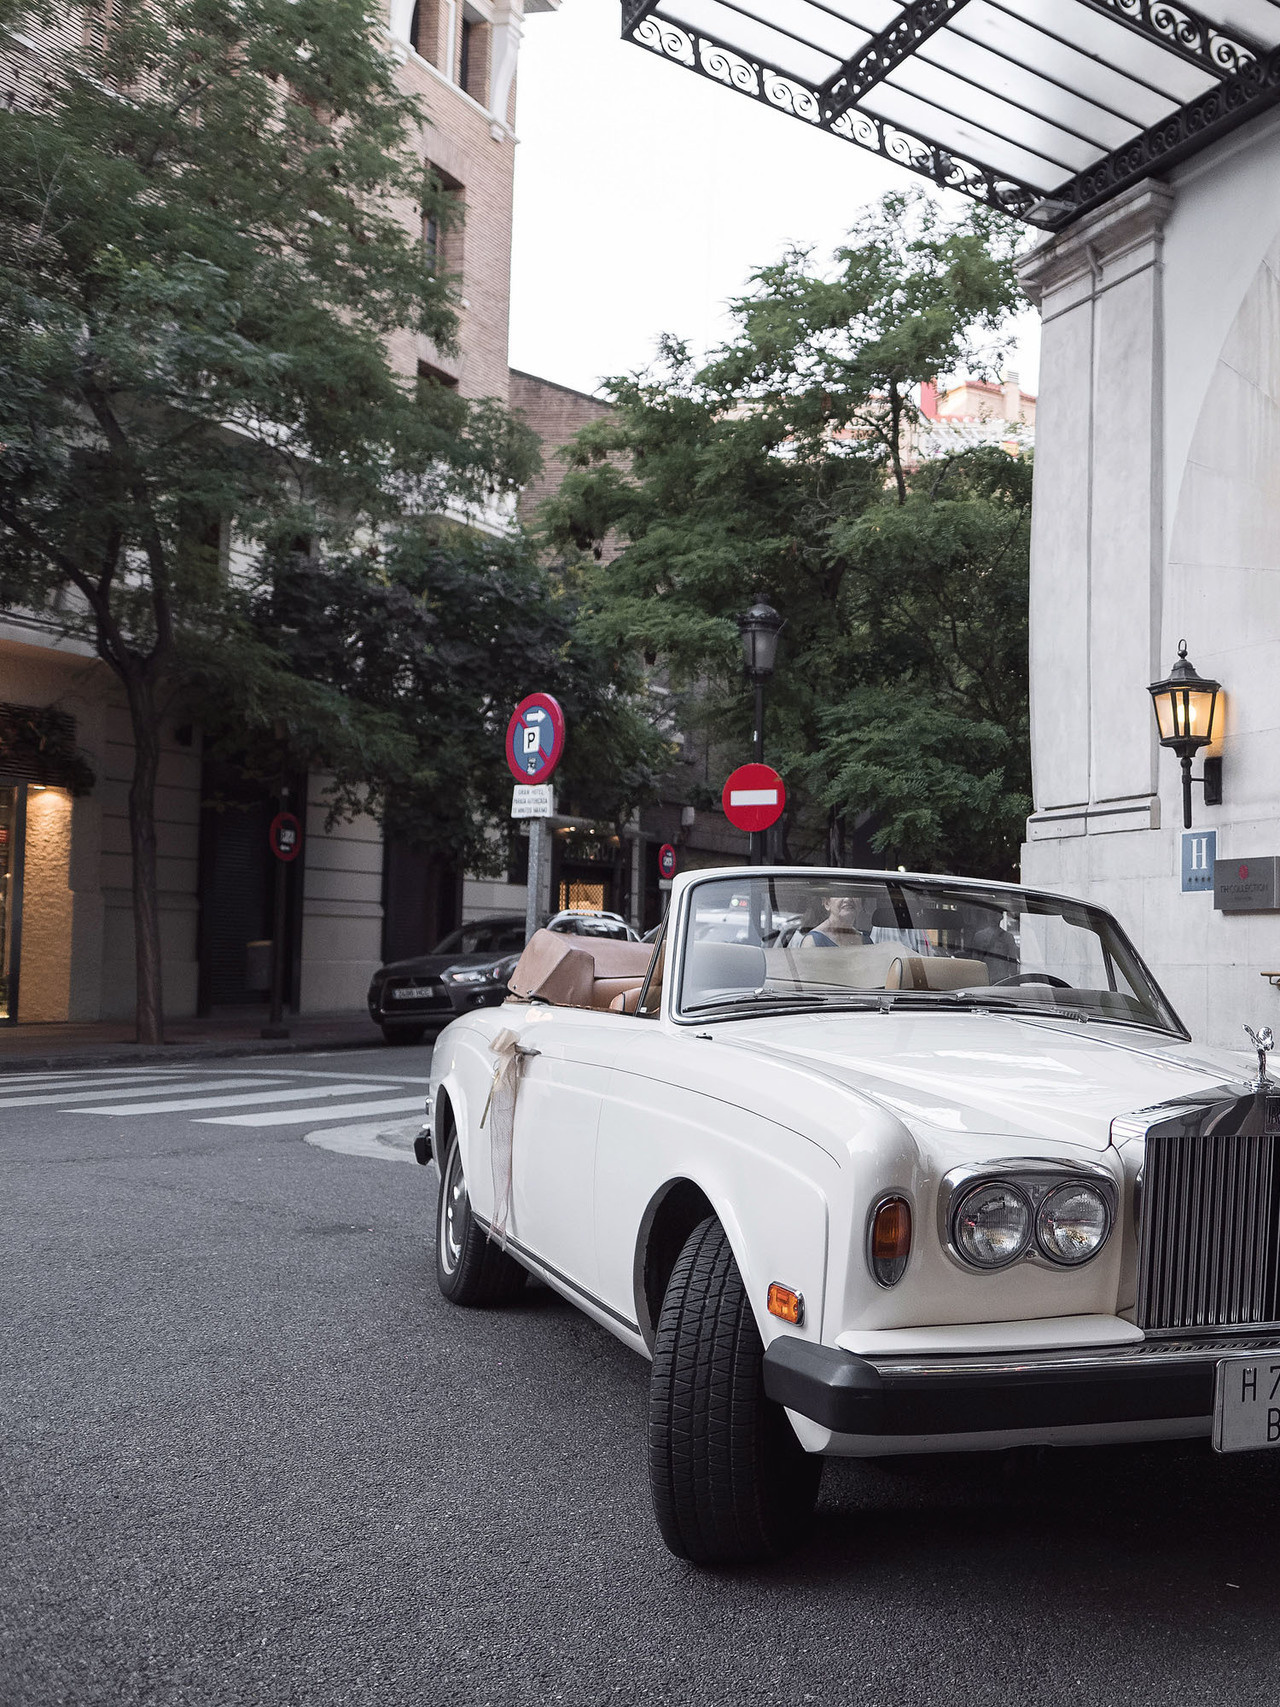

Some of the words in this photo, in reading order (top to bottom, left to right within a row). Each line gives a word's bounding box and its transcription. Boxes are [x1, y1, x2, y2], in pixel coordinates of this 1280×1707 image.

[528, 732, 535, 749] P
[1190, 837, 1209, 871] H
[1242, 1367, 1257, 1403] H
